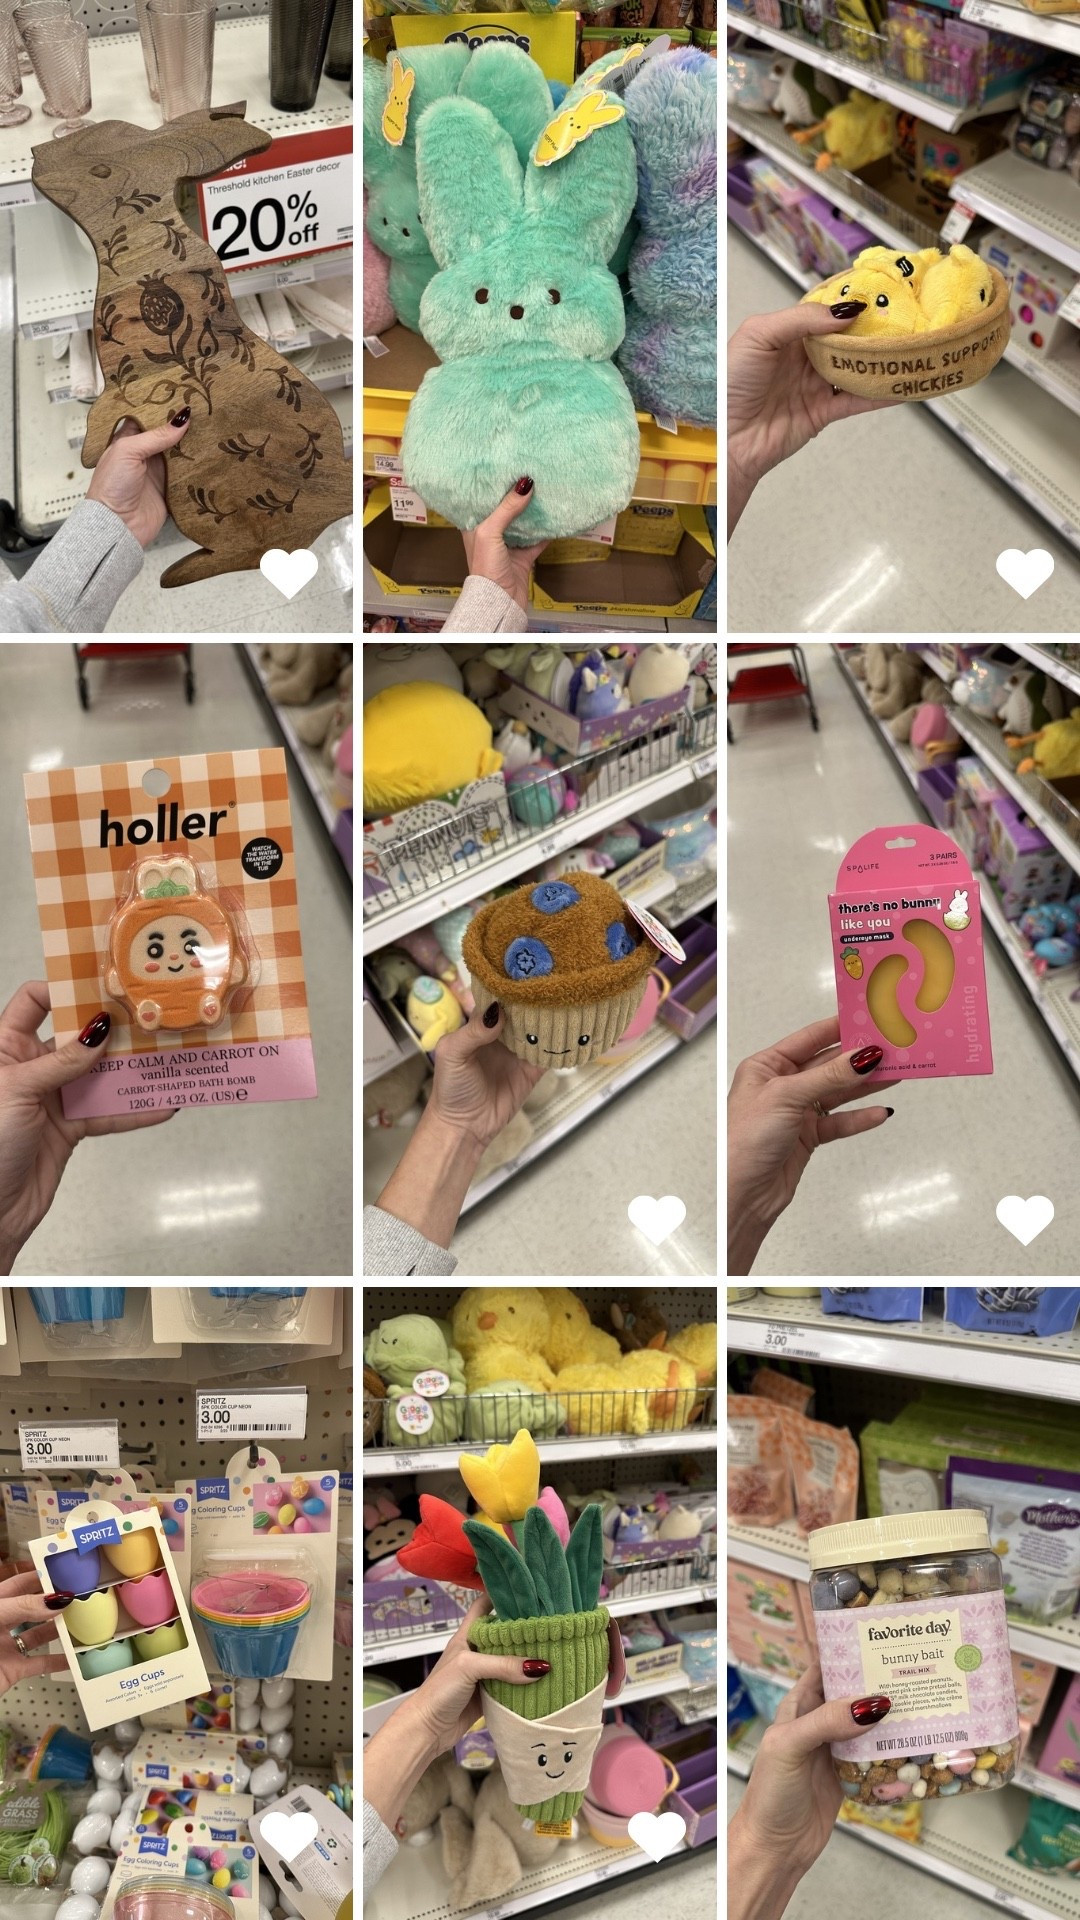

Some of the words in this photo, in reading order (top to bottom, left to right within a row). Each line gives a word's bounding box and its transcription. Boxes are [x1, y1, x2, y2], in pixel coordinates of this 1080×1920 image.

[207, 180, 251, 195] Threshold
[252, 173, 285, 186] kitchen
[287, 167, 314, 179] Easter
[316, 161, 341, 173] decor
[288, 222, 319, 246] off
[831, 355, 936, 375] EMOTIONAL
[892, 370, 964, 396] CHICKIES
[630, 505, 675, 516] Peeps
[573, 604, 608, 612] Peeps
[609, 606, 656, 614] Marshmallow
[100, 802, 227, 848] holler
[936, 852, 958, 860] PAIRS
[838, 902, 880, 914] there's
[883, 901, 899, 911] no
[901, 897, 941, 910] bunny
[840, 919, 863, 930] like
[867, 919, 891, 930] you
[963, 985, 982, 1063] hydrating
[128, 1056, 164, 1069] CALM
[169, 1052, 198, 1065] AND
[201, 1047, 255, 1061] CARROT
[258, 1045, 280, 1057] ON
[141, 1066, 181, 1080] vanilla
[185, 1061, 229, 1076] scented
[117, 1080, 196, 1096] CARROT-SHAPED
[198, 1078, 224, 1088] BATH
[226, 1076, 256, 1086] BOMB
[129, 1098, 155, 1109] 120G
[166, 1095, 187, 1106] 4.23
[189, 1092, 209, 1103] OZ.
[765, 1334, 788, 1346] 3.00
[201, 1410, 231, 1424] 3.00
[26, 1442, 53, 1455] 3.00
[325, 1478, 331, 1486] 5
[200, 1485, 226, 1495] SPRITZ
[198, 1505, 227, 1513] Coloring
[227, 1504, 246, 1512] Cups
[46, 1517, 59, 1525] Egg
[79, 1526, 115, 1544] SPRITZ
[868, 1624, 924, 1641] favorite
[925, 1619, 952, 1637] day
[881, 1652, 919, 1665] bunny
[921, 1648, 945, 1661] bait
[120, 1678, 139, 1690] Egg
[140, 1669, 165, 1681] Cups
[891, 1678, 930, 1688] honey-roasted
[900, 1687, 911, 1695] pink
[929, 1682, 947, 1691] pretzel
[910, 1690, 936, 1699] chocolate
[894, 1699, 912, 1707] cookie
[914, 1702, 952, 1711] marshmallows
[876, 1739, 887, 1752] NET
[887, 1738, 897, 1751] WT
[897, 1737, 909, 1749] 28.5
[909, 1735, 917, 1748] OZ
[925, 1733, 932, 1746] LB
[932, 1731, 944, 1745] 12.5
[6, 1796, 41, 1808] edible
[2, 1808, 39, 1818] GRASS
[143, 1841, 166, 1850] SPRITZ
[123, 1855, 136, 1864] Egg
[136, 1857, 162, 1867] Coloring
[163, 1860, 180, 1868] Cups
